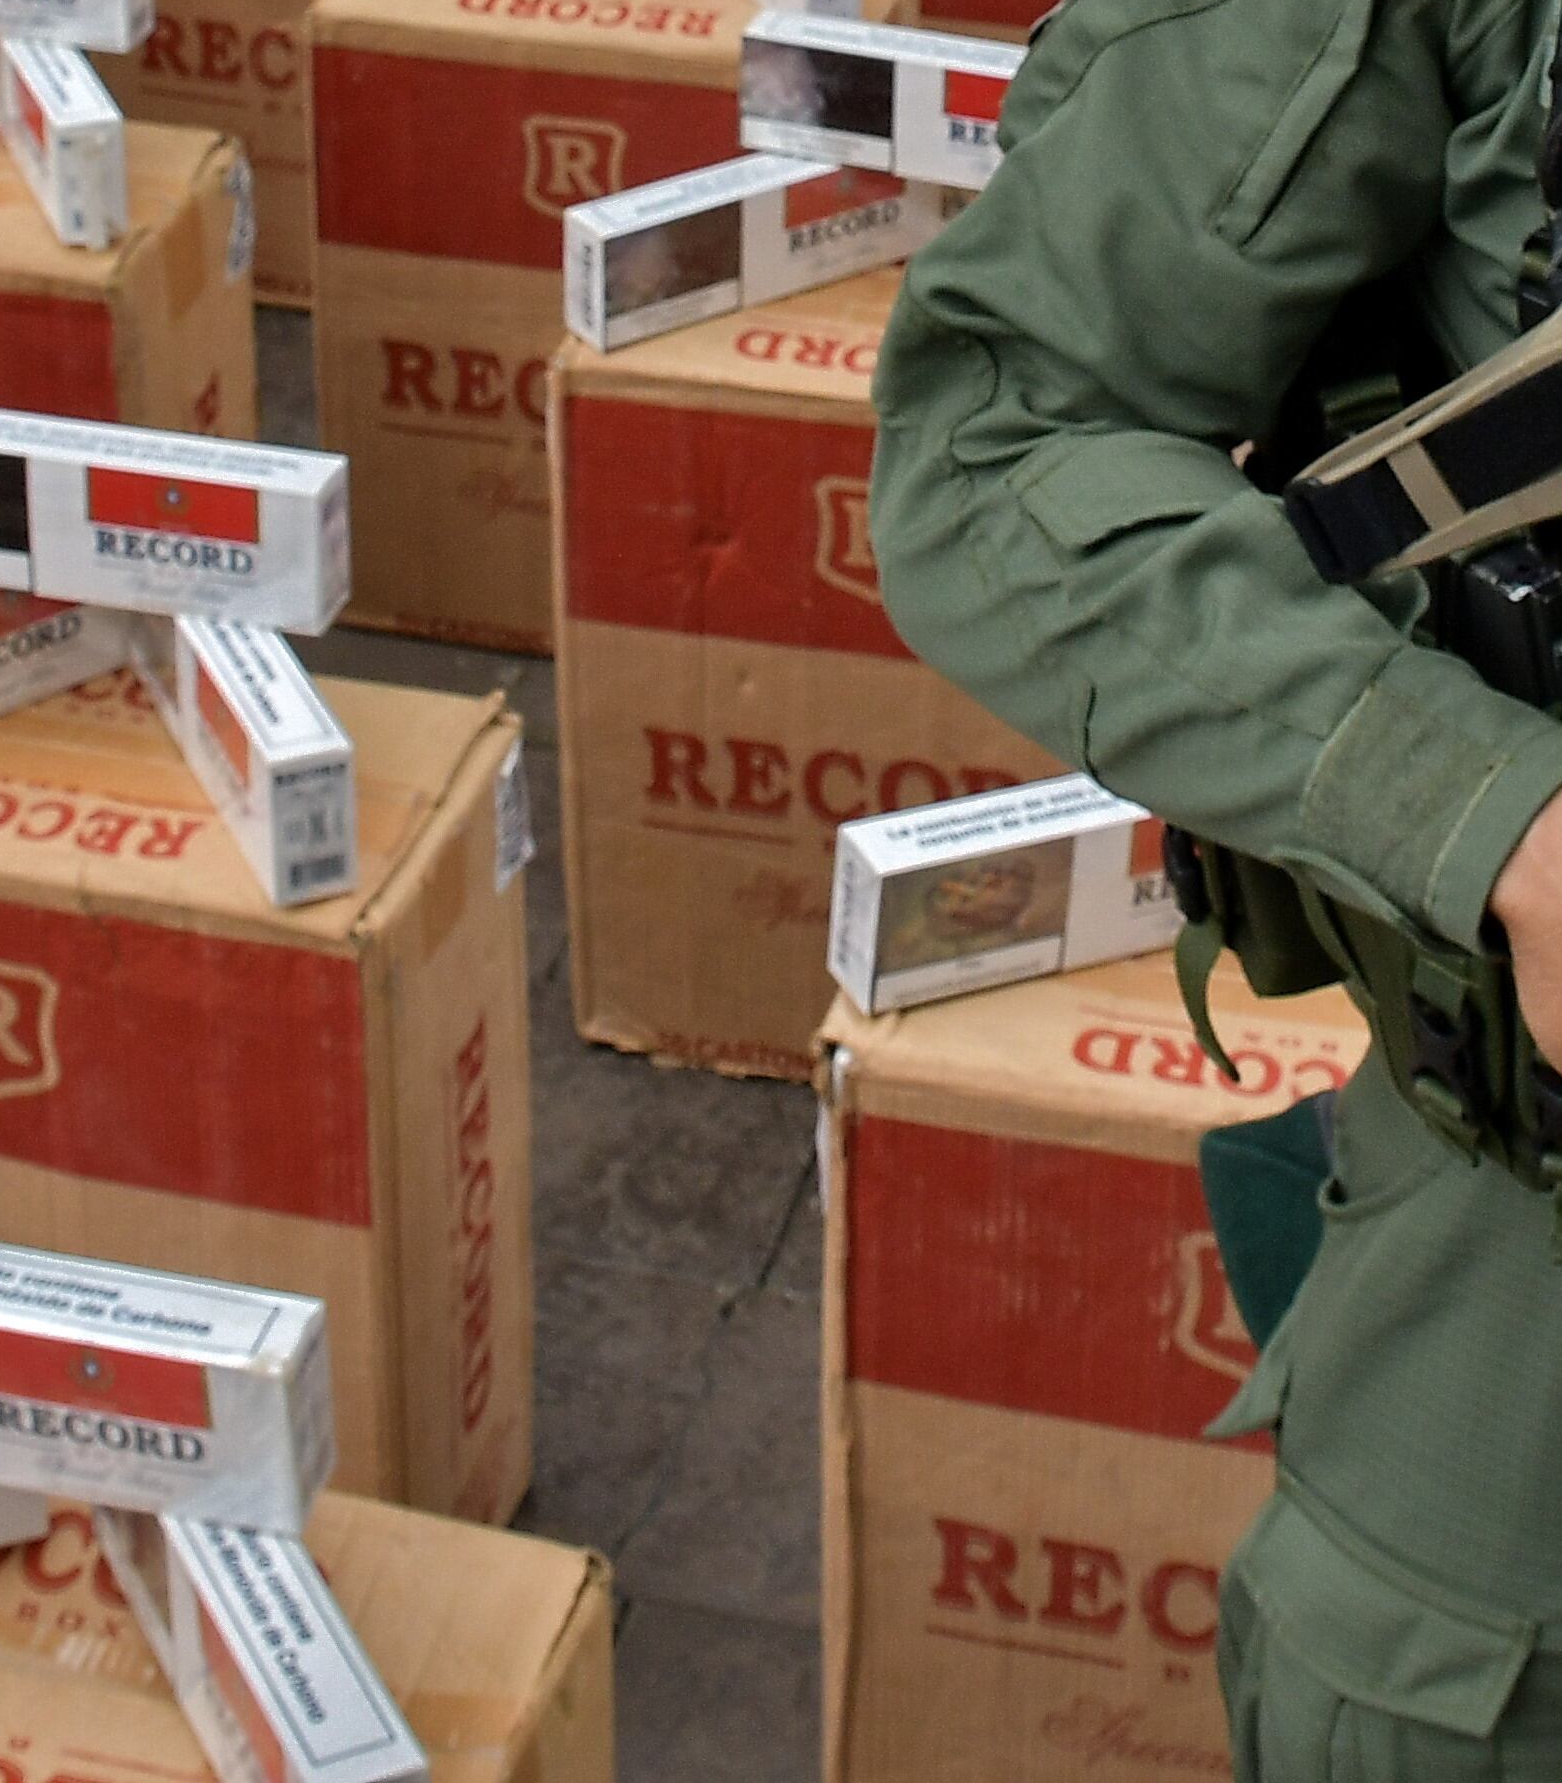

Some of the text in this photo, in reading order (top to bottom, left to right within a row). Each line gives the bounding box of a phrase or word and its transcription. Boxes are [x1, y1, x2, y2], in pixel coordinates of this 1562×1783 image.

[146, 18, 297, 89] REC
[787, 203, 900, 254] RECORD
[380, 340, 547, 419] REC
[735, 327, 877, 373] ORD
[94, 528, 254, 577] RECORD
[1071, 1026, 1347, 1099] CORD
[452, 1020, 496, 1433] RECORD
[933, 1517, 1218, 1649] REC
